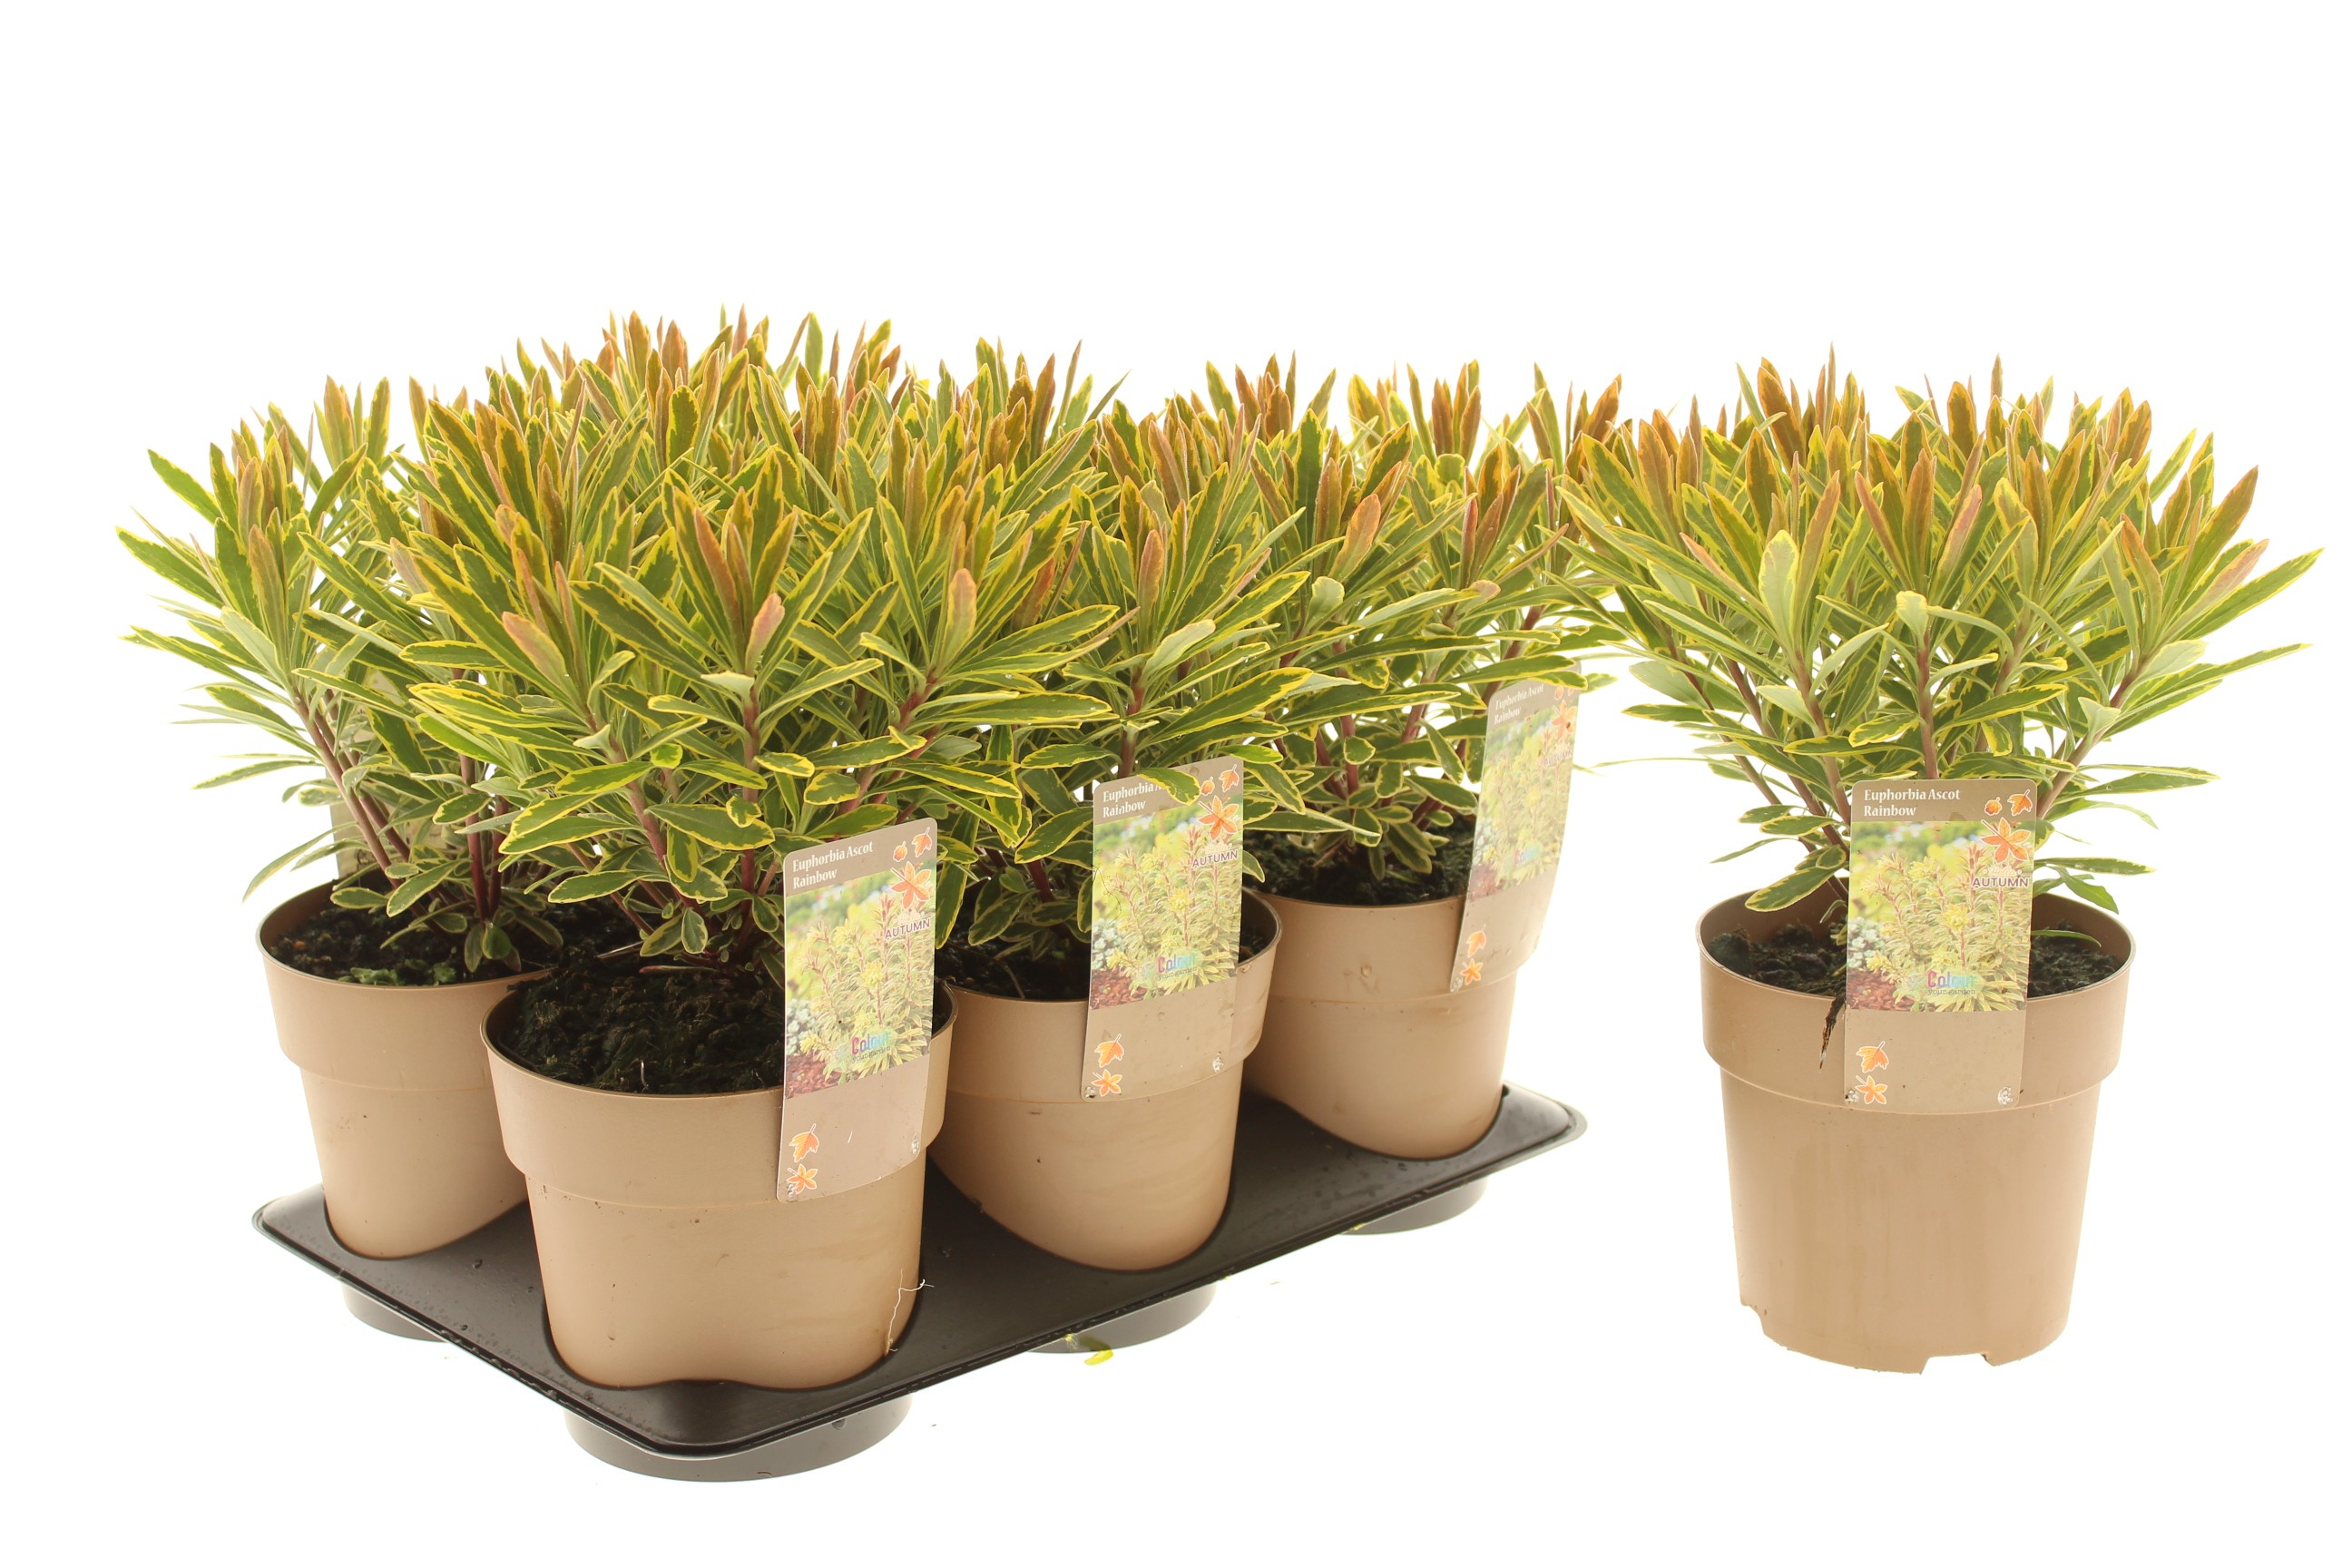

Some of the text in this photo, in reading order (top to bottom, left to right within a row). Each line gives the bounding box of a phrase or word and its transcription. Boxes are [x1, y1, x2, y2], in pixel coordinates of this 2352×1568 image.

[1102, 782, 1154, 803] Euphorbia
[1864, 789, 1961, 803] Euphorbia Ascot
[1102, 800, 1146, 818] Rainbow
[1864, 805, 1916, 817] Rainbow
[792, 841, 874, 873] Euphorbia Ascot
[1192, 849, 1239, 868] AUTUMN
[793, 868, 838, 889] Rainbow
[1972, 877, 2029, 887] AUTUMN
[885, 918, 930, 939] AUTUMN
[1927, 970, 1975, 988] Colour
